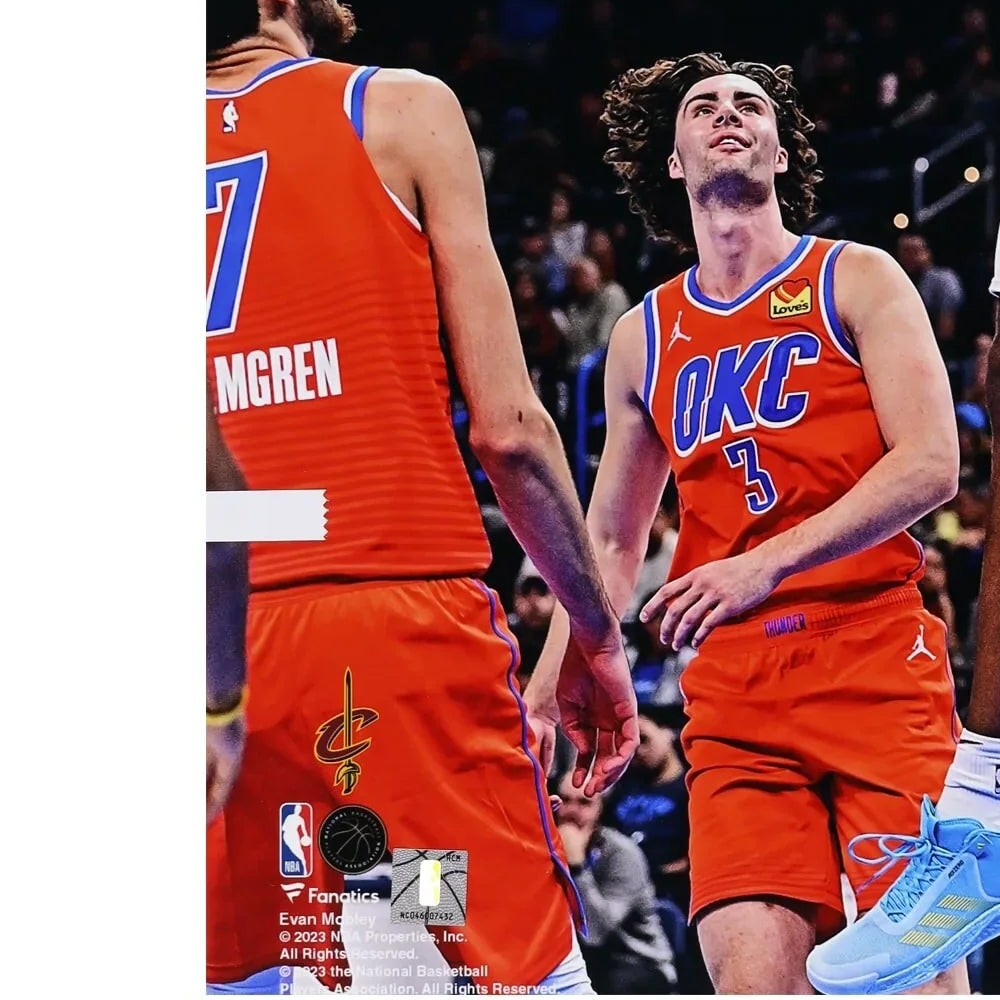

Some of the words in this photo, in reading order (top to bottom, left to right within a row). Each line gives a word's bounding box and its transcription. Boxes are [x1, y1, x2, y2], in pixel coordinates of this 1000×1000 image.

[214, 337, 342, 415] MGREN
[671, 331, 821, 458] OKC
[721, 436, 779, 516] 3
[763, 612, 808, 639] THUNDER
